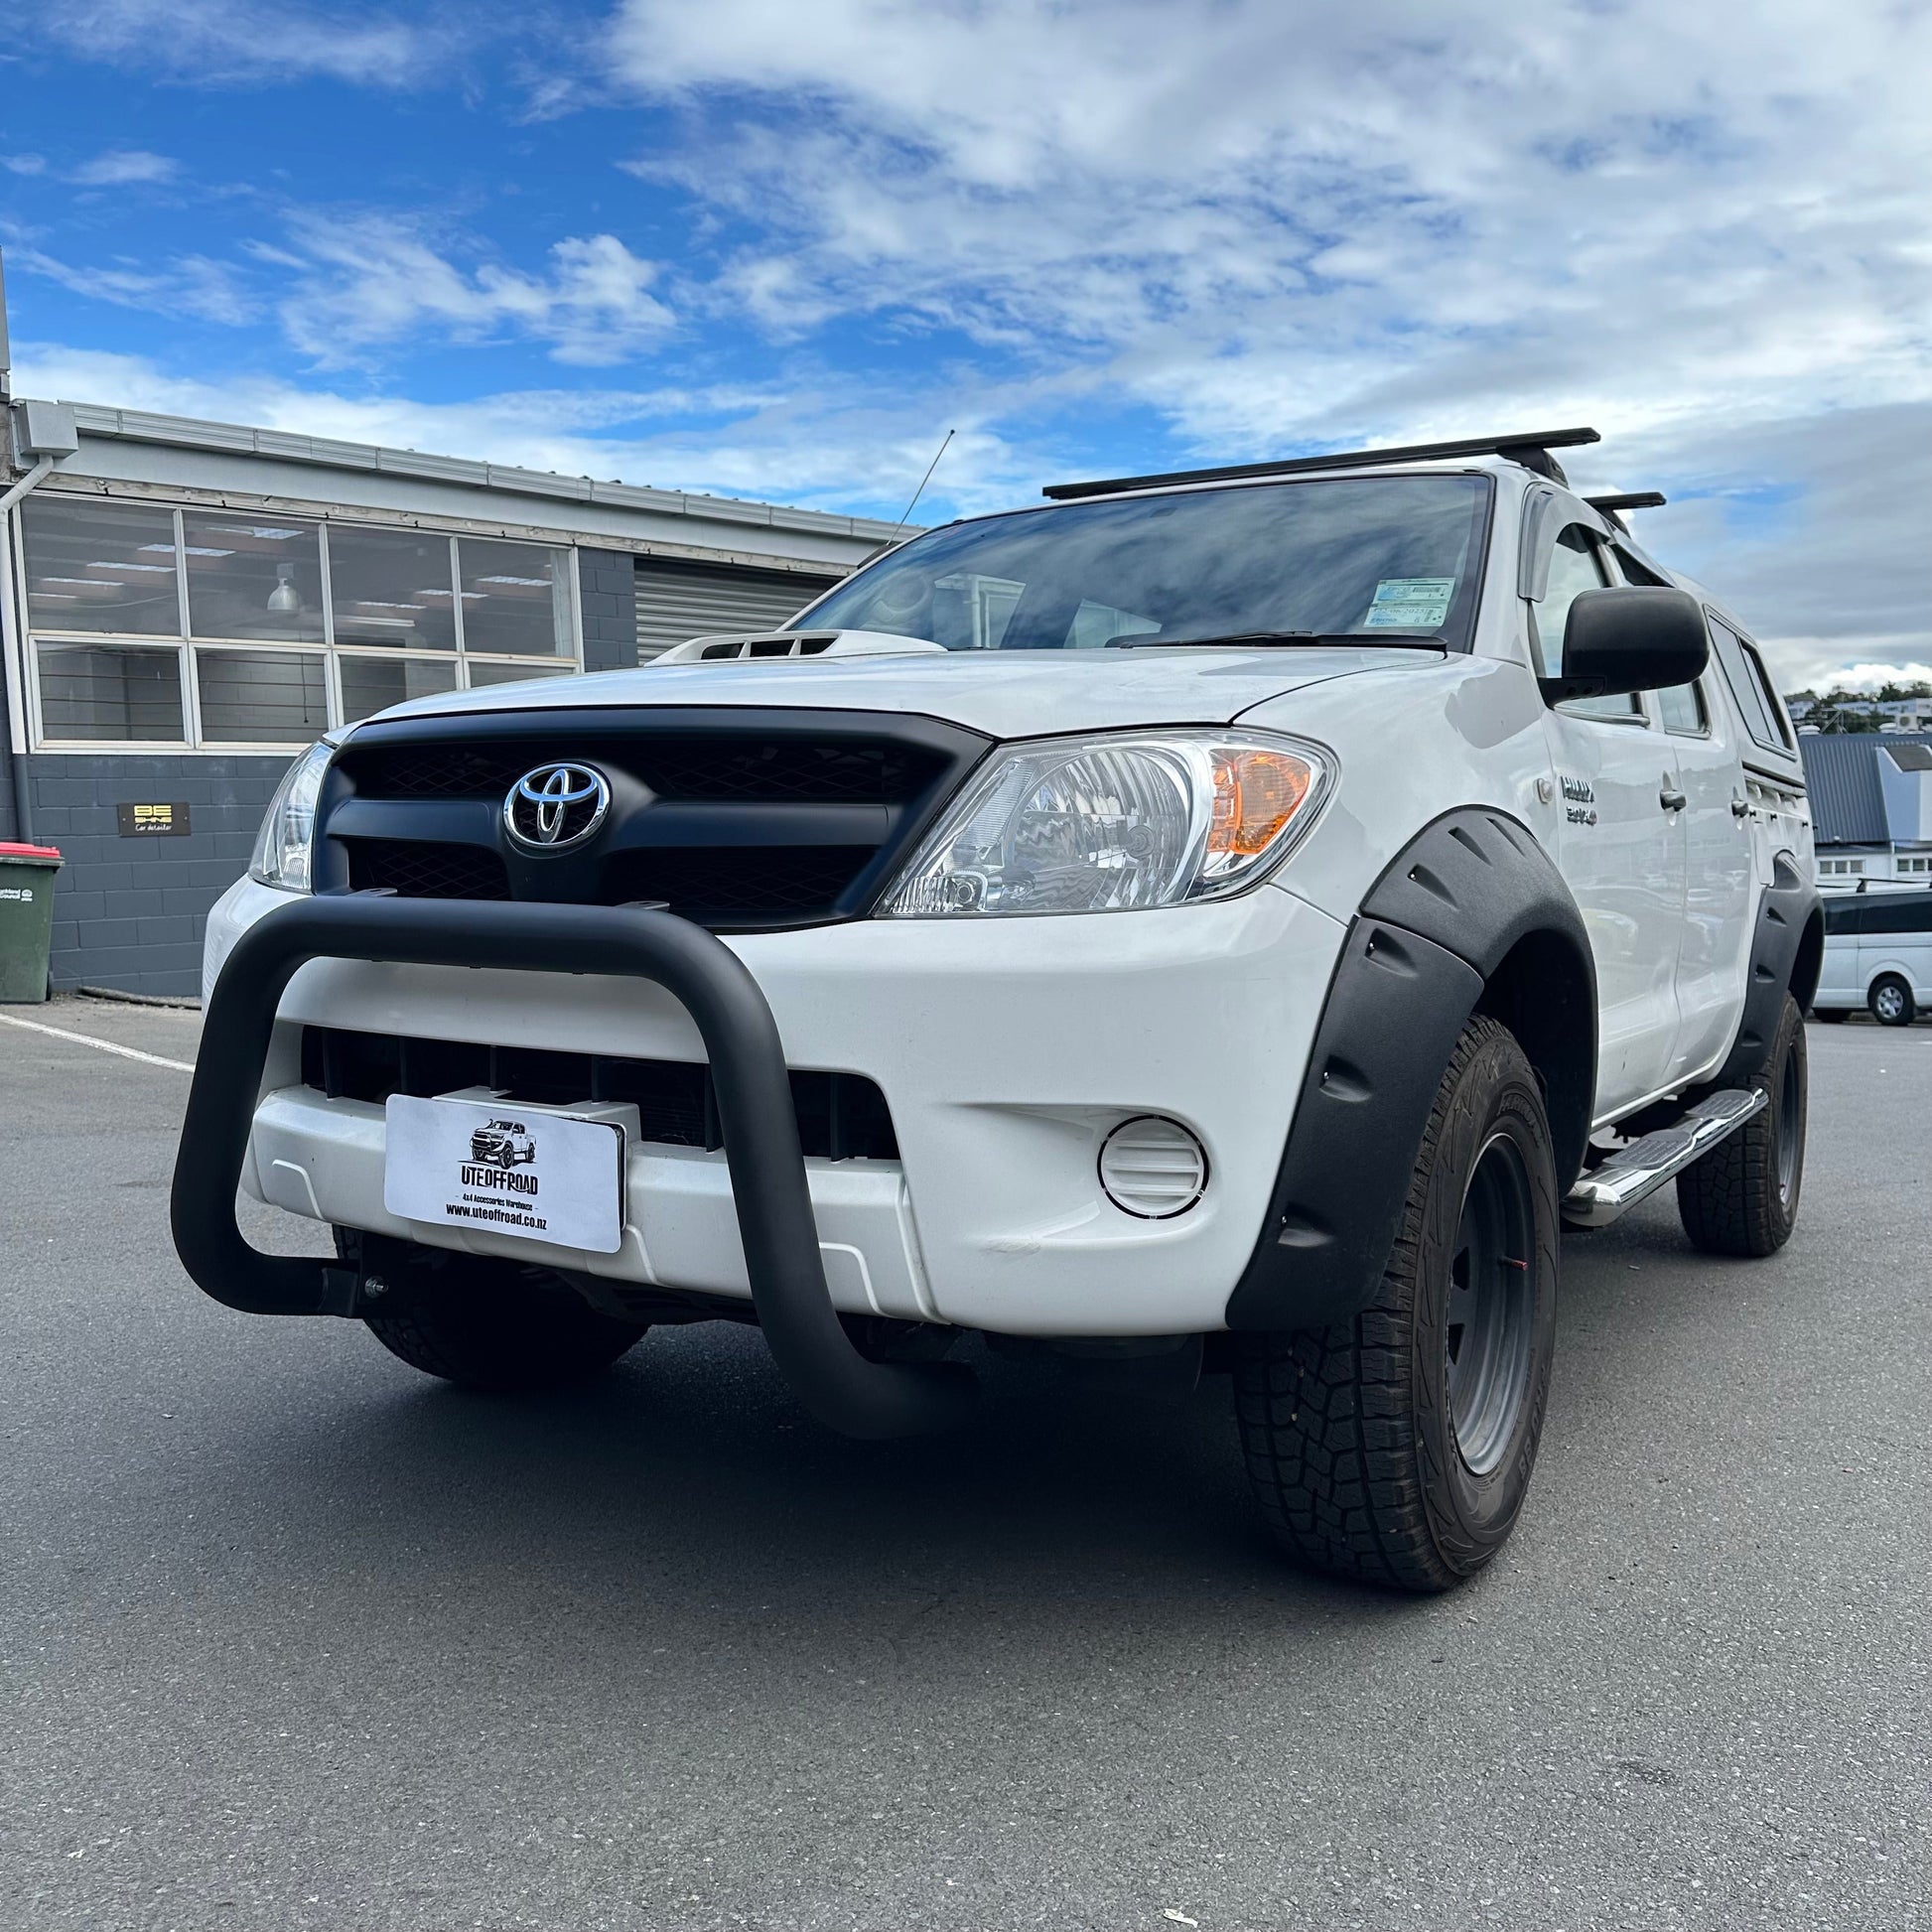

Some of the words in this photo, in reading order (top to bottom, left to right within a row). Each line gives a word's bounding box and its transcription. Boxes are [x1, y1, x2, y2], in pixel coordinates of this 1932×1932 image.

[134, 805, 172, 816] BE
[461, 1166, 538, 1195] UTEOFFROAD
[463, 1192, 474, 1201] 4x4
[474, 1194, 505, 1206] Accessories
[505, 1198, 533, 1211] Warehouse
[446, 1203, 547, 1230] www.uteoffroad.co.nz
